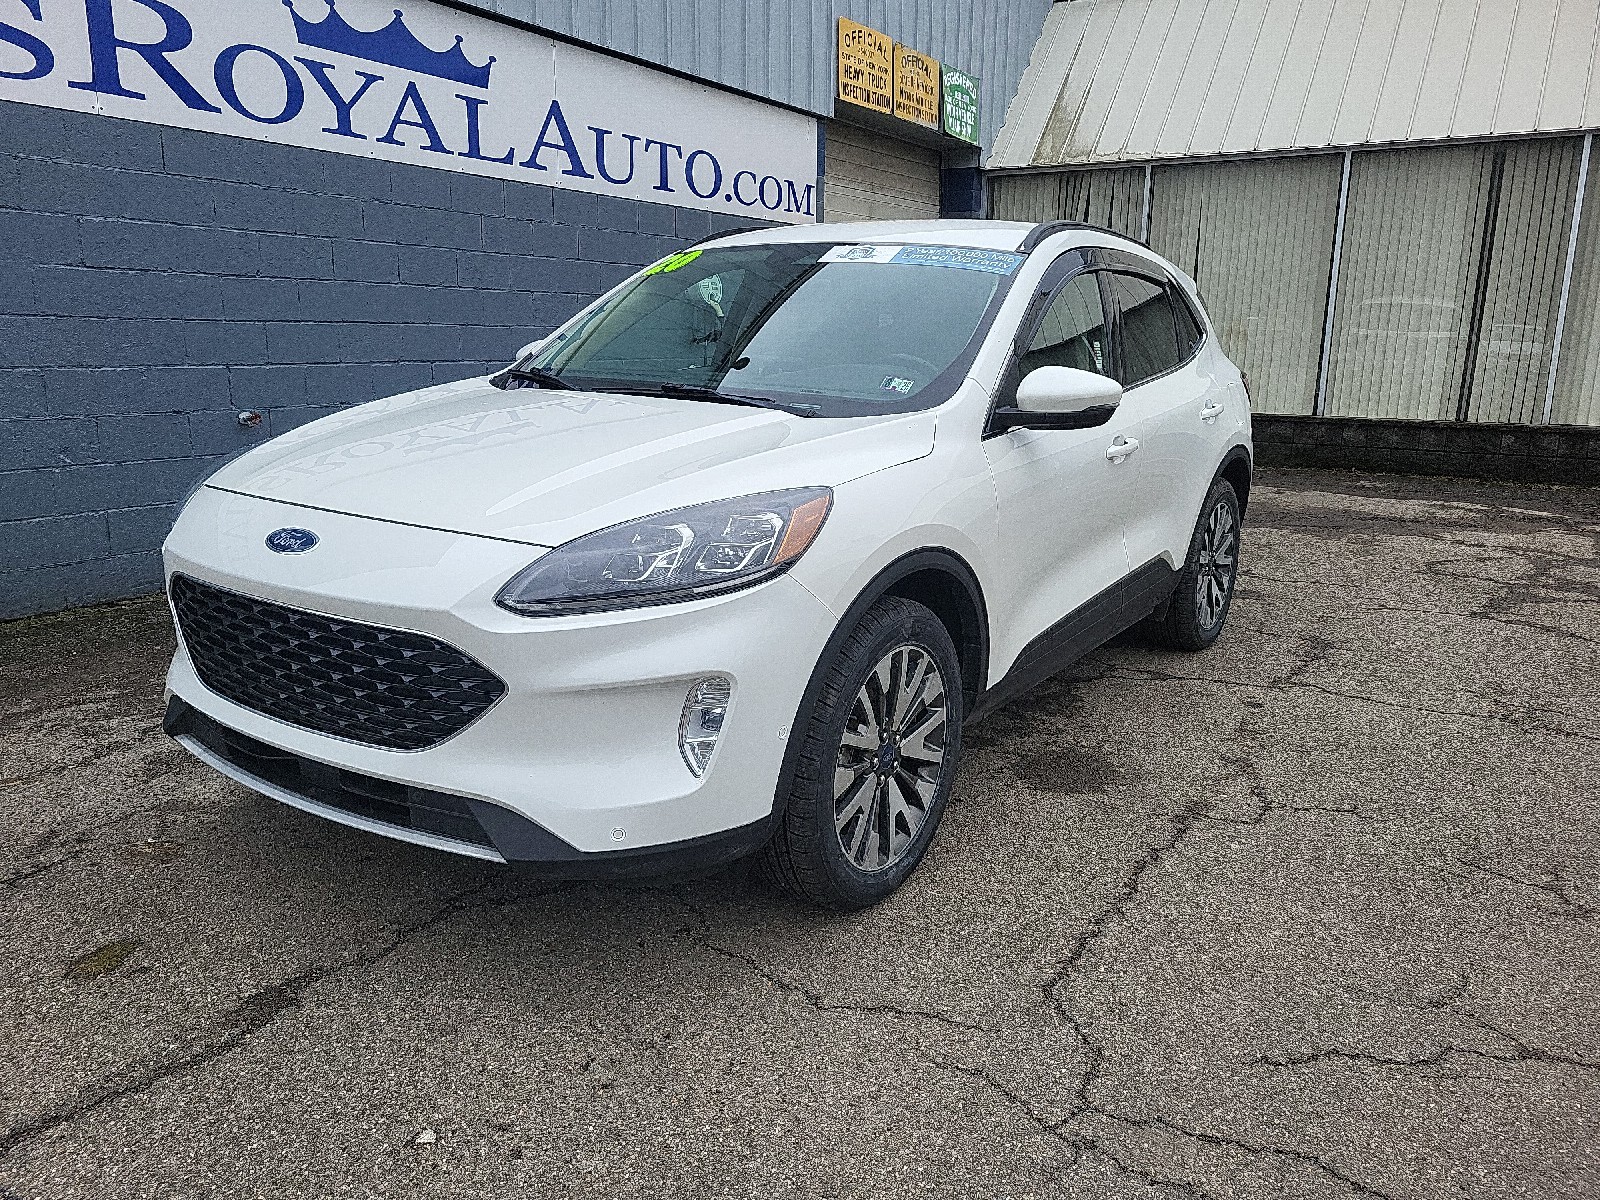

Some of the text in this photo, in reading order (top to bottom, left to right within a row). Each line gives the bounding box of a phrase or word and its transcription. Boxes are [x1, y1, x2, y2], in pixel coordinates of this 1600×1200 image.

[844, 30, 888, 62] OFFICIAL
[844, 64, 865, 84] HEAVY
[867, 72, 888, 91] TRUCK
[901, 55, 933, 83] OFFICIAL
[840, 81, 891, 110] INSPECTION STATION
[901, 253, 949, 262] Limited
[951, 255, 1012, 269] Warranty
